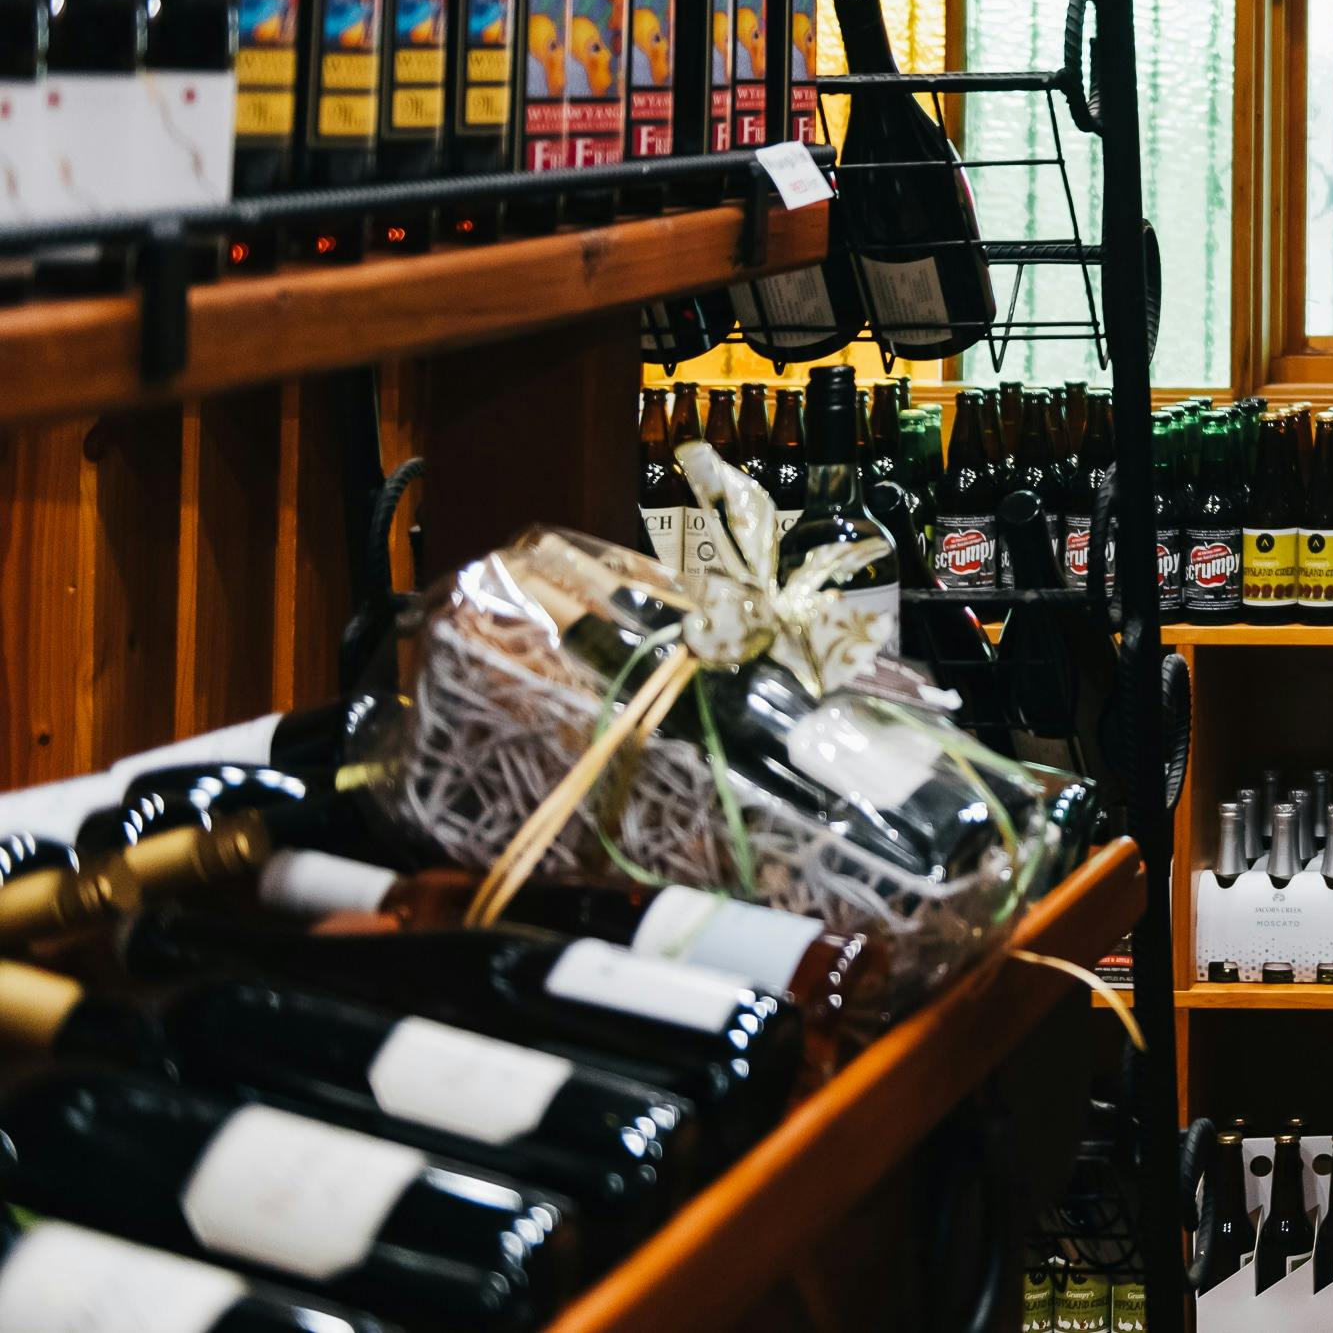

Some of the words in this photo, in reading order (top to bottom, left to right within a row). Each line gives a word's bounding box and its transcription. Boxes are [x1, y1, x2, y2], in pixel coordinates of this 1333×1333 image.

[645, 515, 672, 531] CH
[686, 516, 705, 531] LO
[934, 538, 996, 570] scrumpy
[1185, 552, 1240, 581] scrumpy
[1256, 920, 1300, 928] MOSCATO
[1066, 1290, 1095, 1300] Grumpy's
